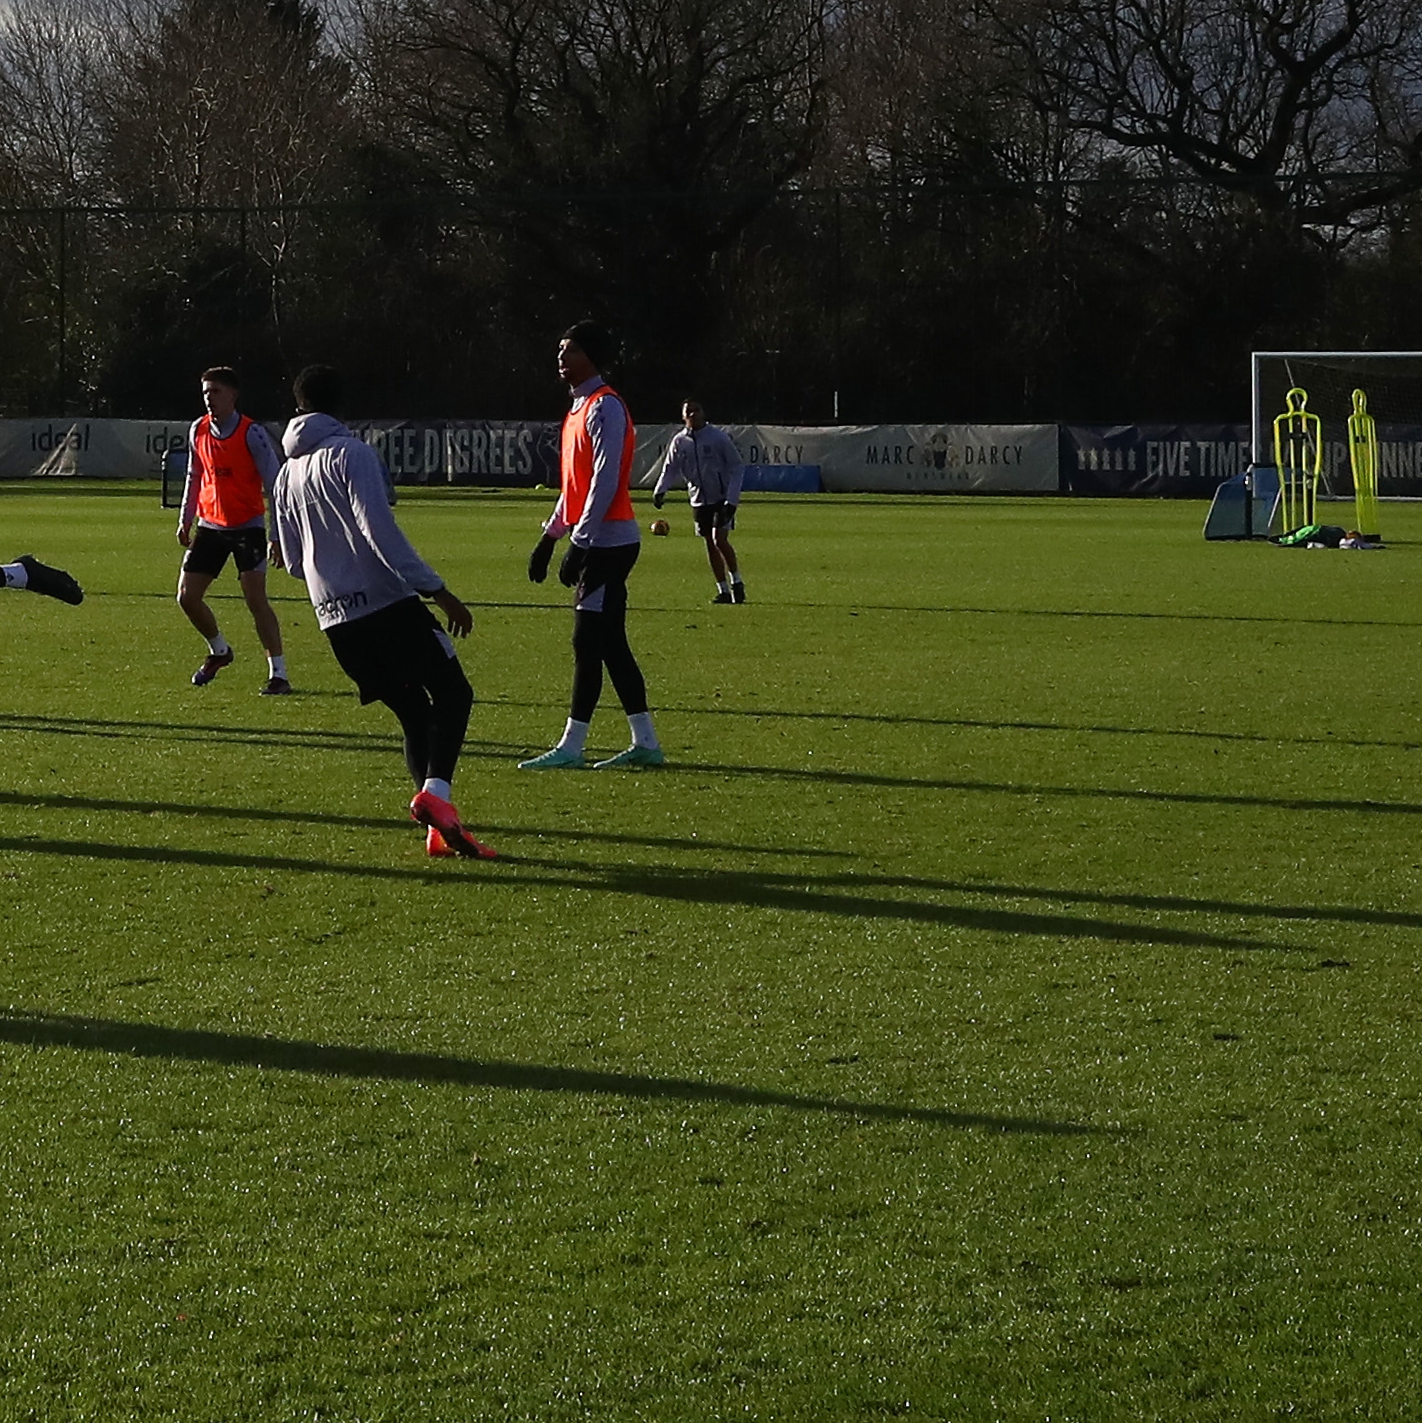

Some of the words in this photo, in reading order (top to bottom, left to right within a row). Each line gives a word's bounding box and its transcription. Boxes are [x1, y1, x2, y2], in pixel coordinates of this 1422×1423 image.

[424, 428, 534, 475] DEGREES
[750, 445, 804, 465] DARCY
[865, 445, 915, 465] MARC
[964, 445, 1023, 465] DARCY
[1146, 440, 1192, 477] FIVE
[1196, 440, 1250, 477] TIME
[318, 591, 368, 616] acron
